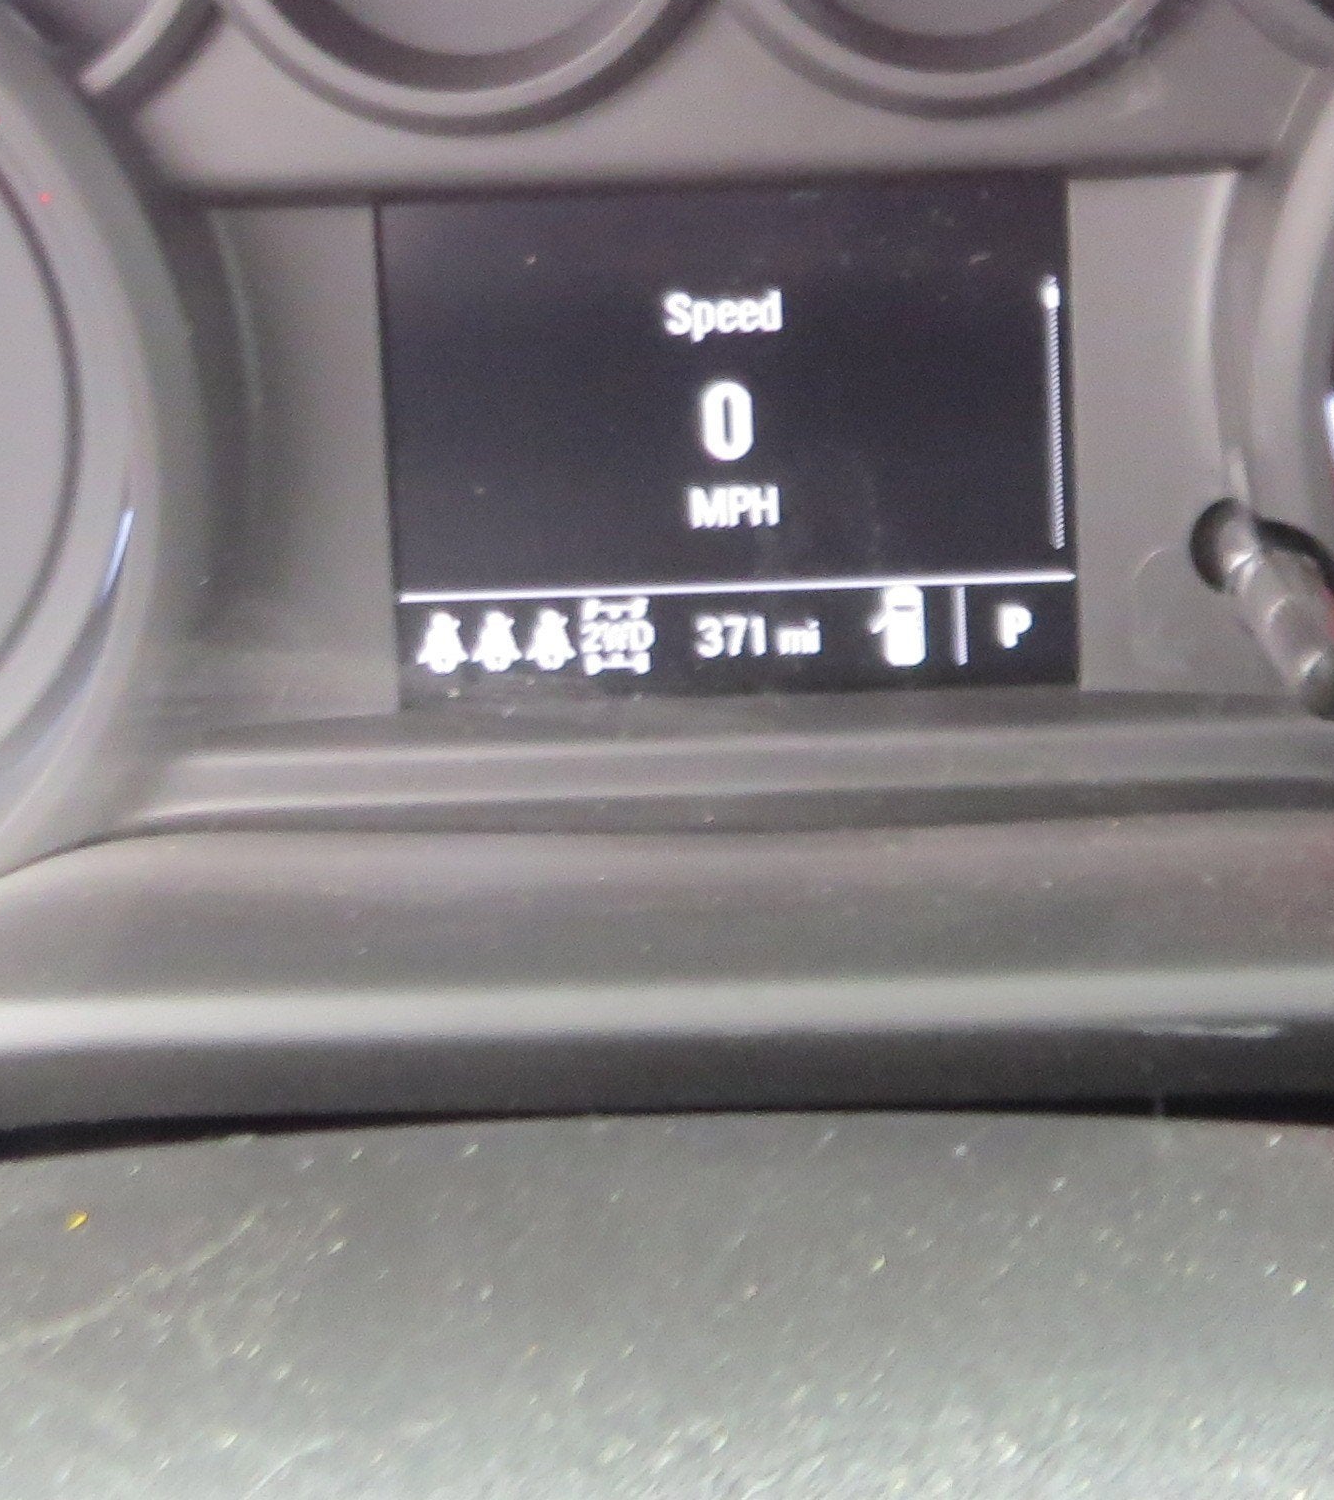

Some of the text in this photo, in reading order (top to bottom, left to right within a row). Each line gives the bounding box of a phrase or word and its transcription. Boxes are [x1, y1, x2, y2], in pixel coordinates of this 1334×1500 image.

[664, 289, 783, 343] Speed
[702, 381, 754, 460] 0
[688, 486, 780, 529] MPH
[581, 619, 656, 653] 2WD
[695, 616, 821, 658] 371 mi
[998, 606, 1033, 649] P
